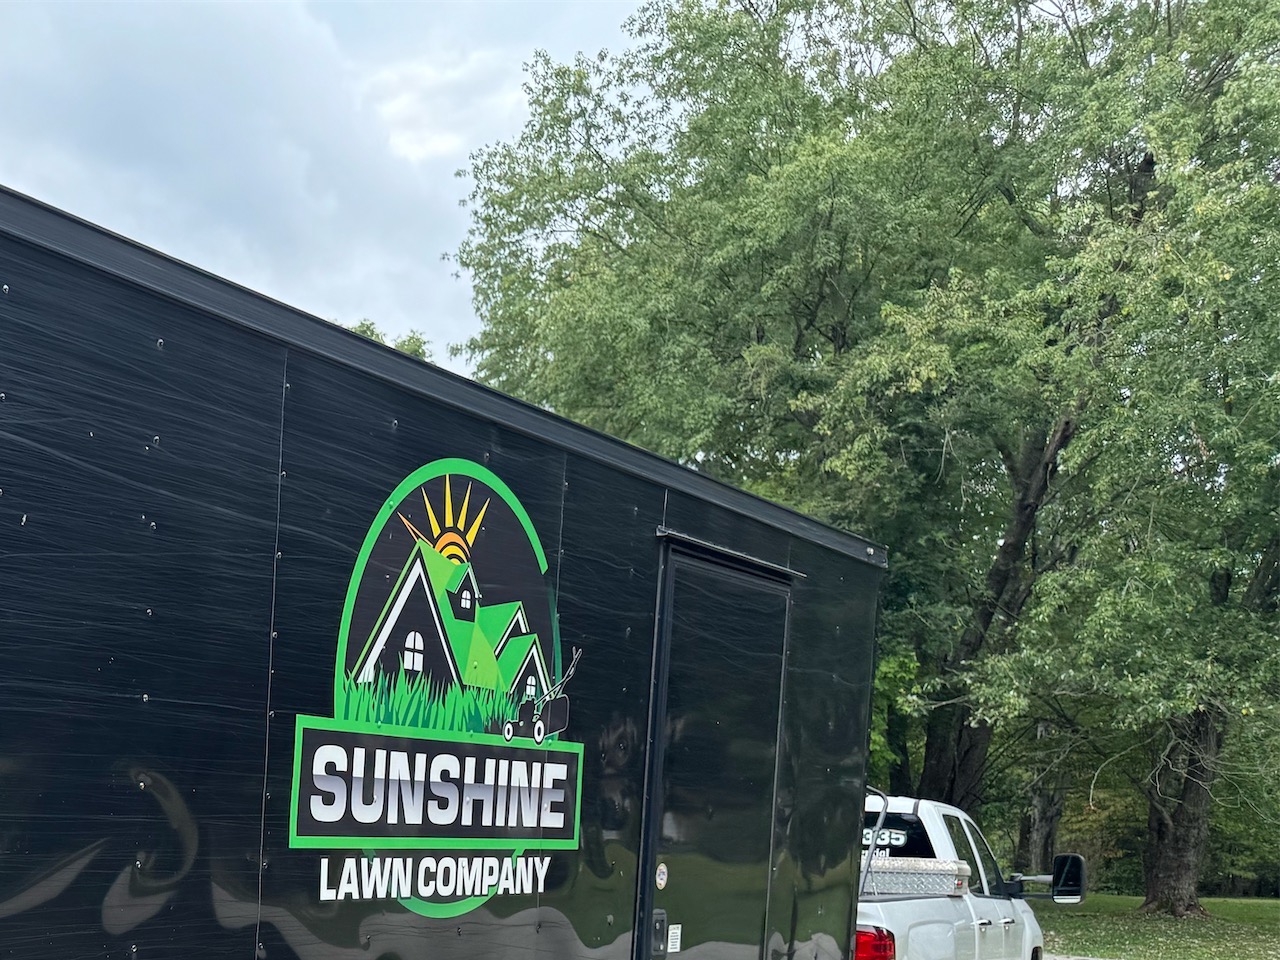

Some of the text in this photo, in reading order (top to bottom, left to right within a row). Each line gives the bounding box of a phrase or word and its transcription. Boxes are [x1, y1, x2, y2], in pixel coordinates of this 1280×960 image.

[309, 744, 568, 829] SUNSHINE
[861, 828, 906, 846] 335
[319, 856, 551, 901] LAWN COMPANY
